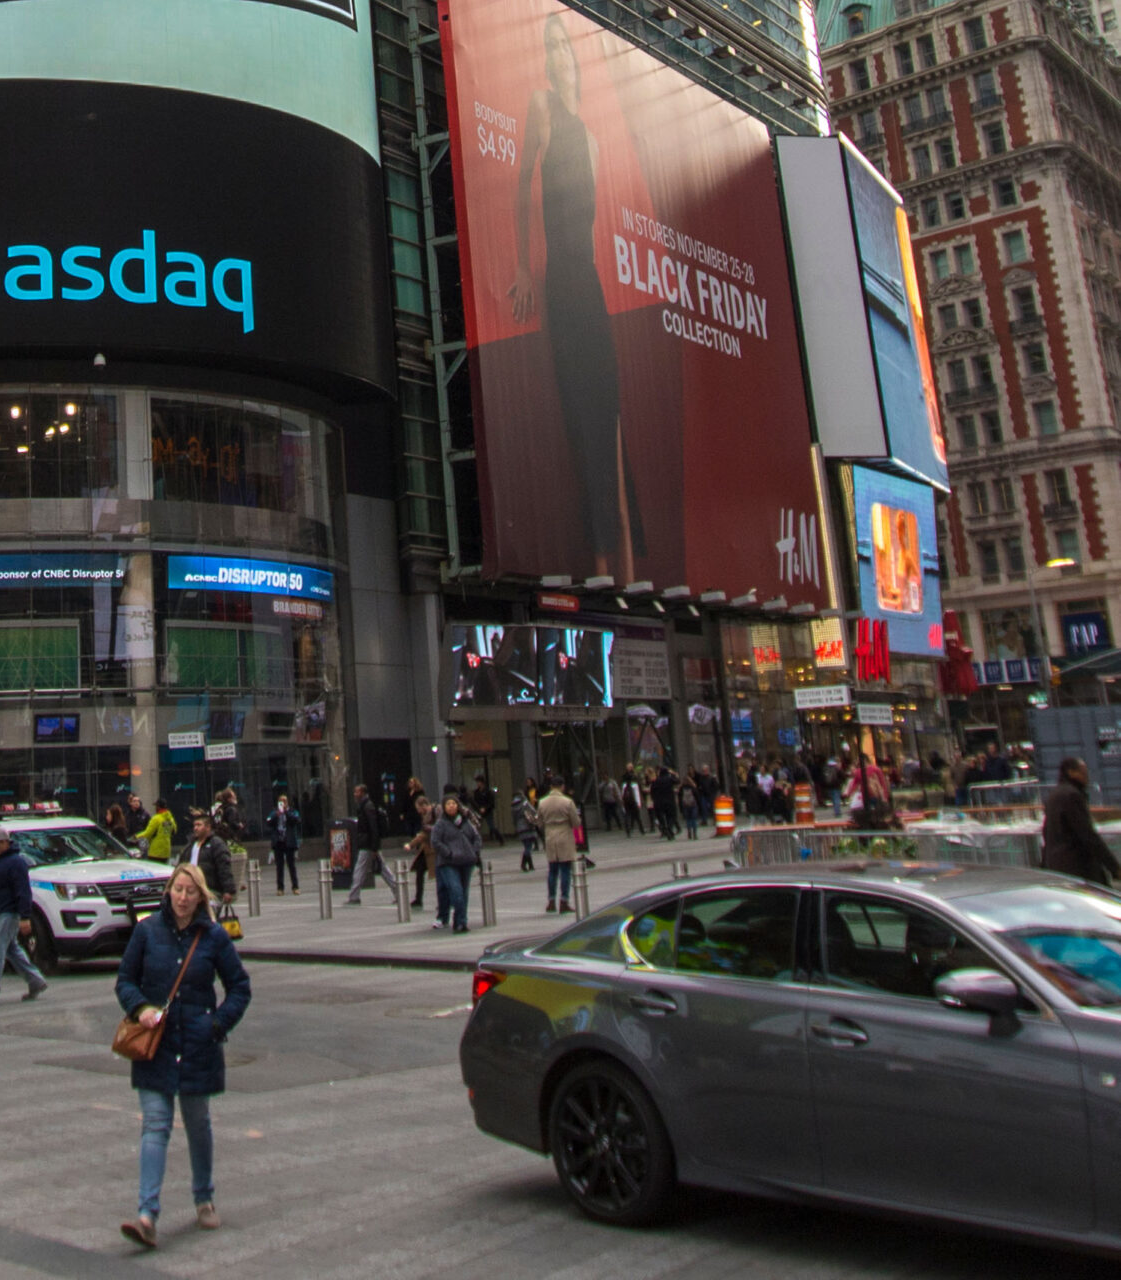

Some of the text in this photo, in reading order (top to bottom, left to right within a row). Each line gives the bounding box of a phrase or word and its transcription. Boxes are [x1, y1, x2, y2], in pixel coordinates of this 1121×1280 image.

[474, 101, 516, 134] BODYSUIT
[477, 123, 516, 166] $4.99
[621, 206, 755, 286] IN STORES NOVEMBER 25-28
[614, 234, 768, 341] BLACK FRIDAY
[662, 309, 742, 359] COLLECTION
[776, 507, 821, 591] H&M
[31, 569, 41, 579] of
[43, 569, 70, 579] CNBC
[72, 569, 114, 580] Disruptor
[218, 567, 287, 588] DISRUPTOR
[289, 573, 303, 591] 50
[855, 618, 891, 684] H&M
